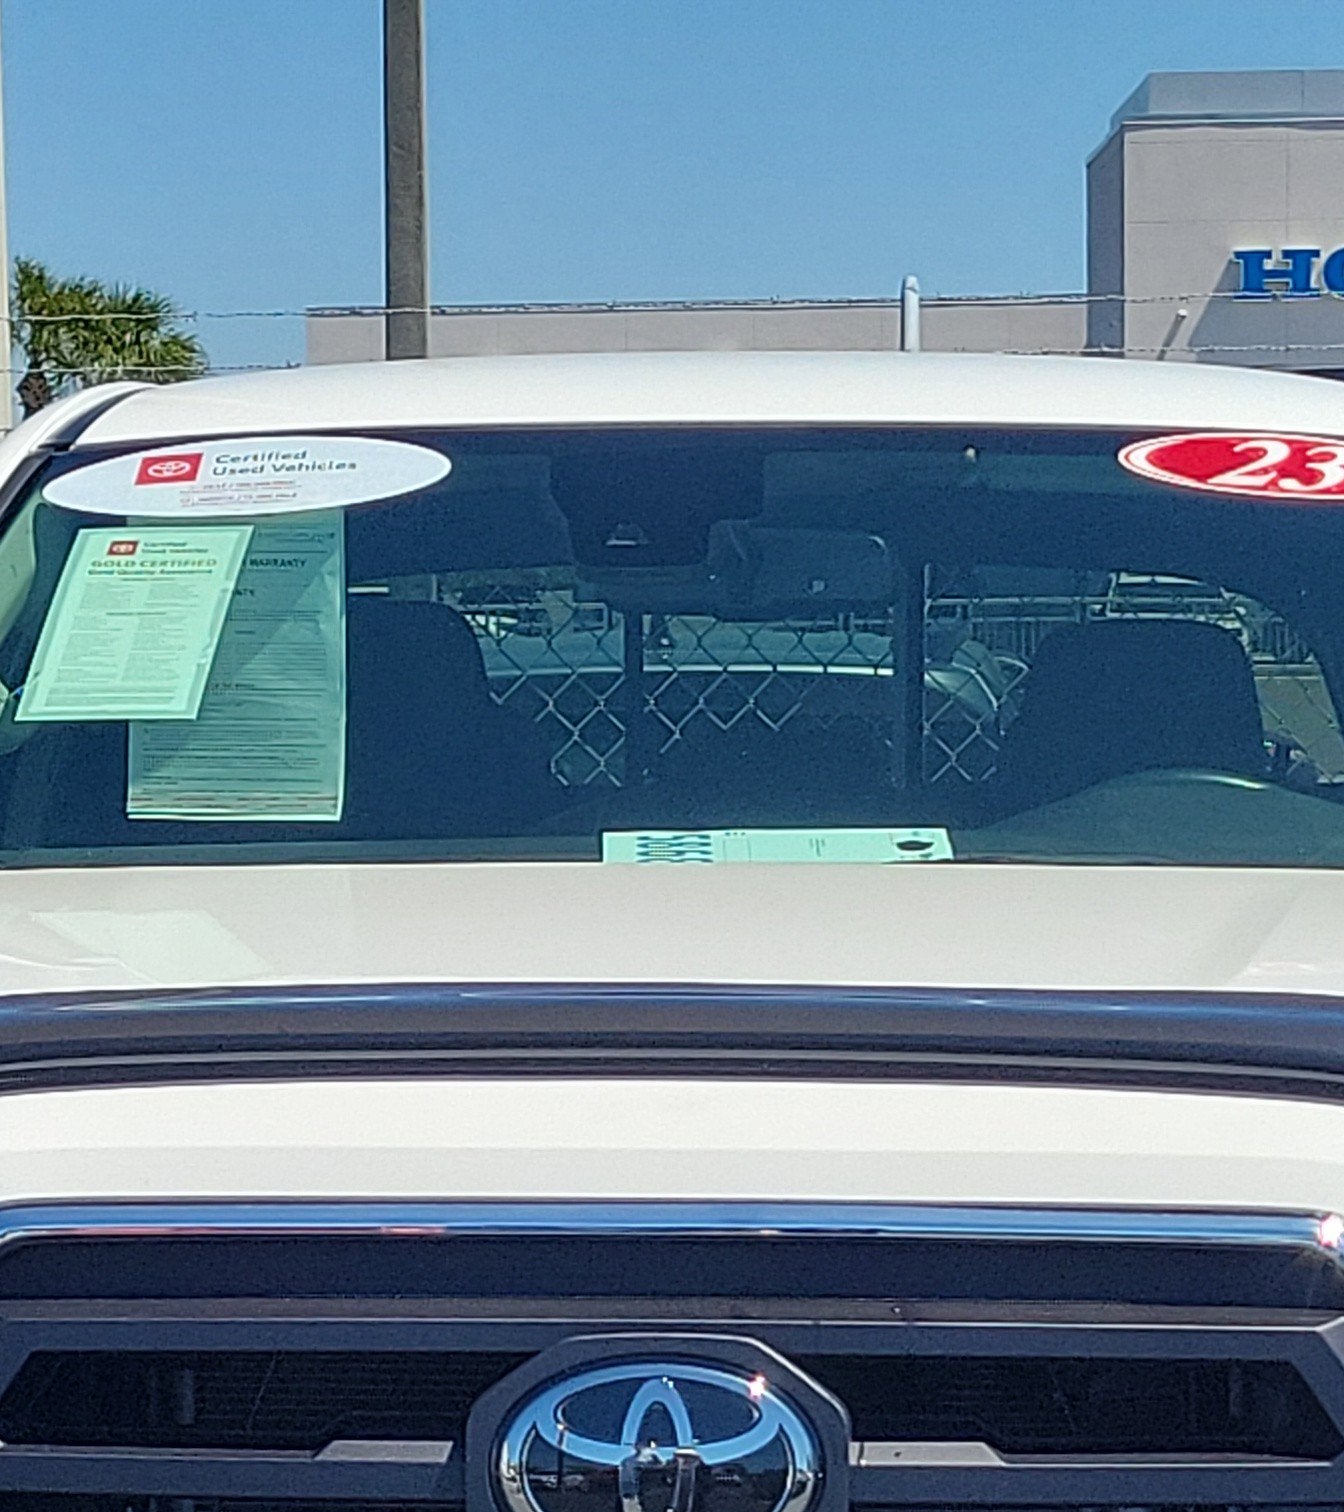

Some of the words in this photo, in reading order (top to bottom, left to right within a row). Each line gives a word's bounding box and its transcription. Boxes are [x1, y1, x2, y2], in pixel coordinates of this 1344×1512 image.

[215, 450, 308, 464] Certified
[212, 462, 265, 476] Used
[271, 461, 358, 473] Vehicles
